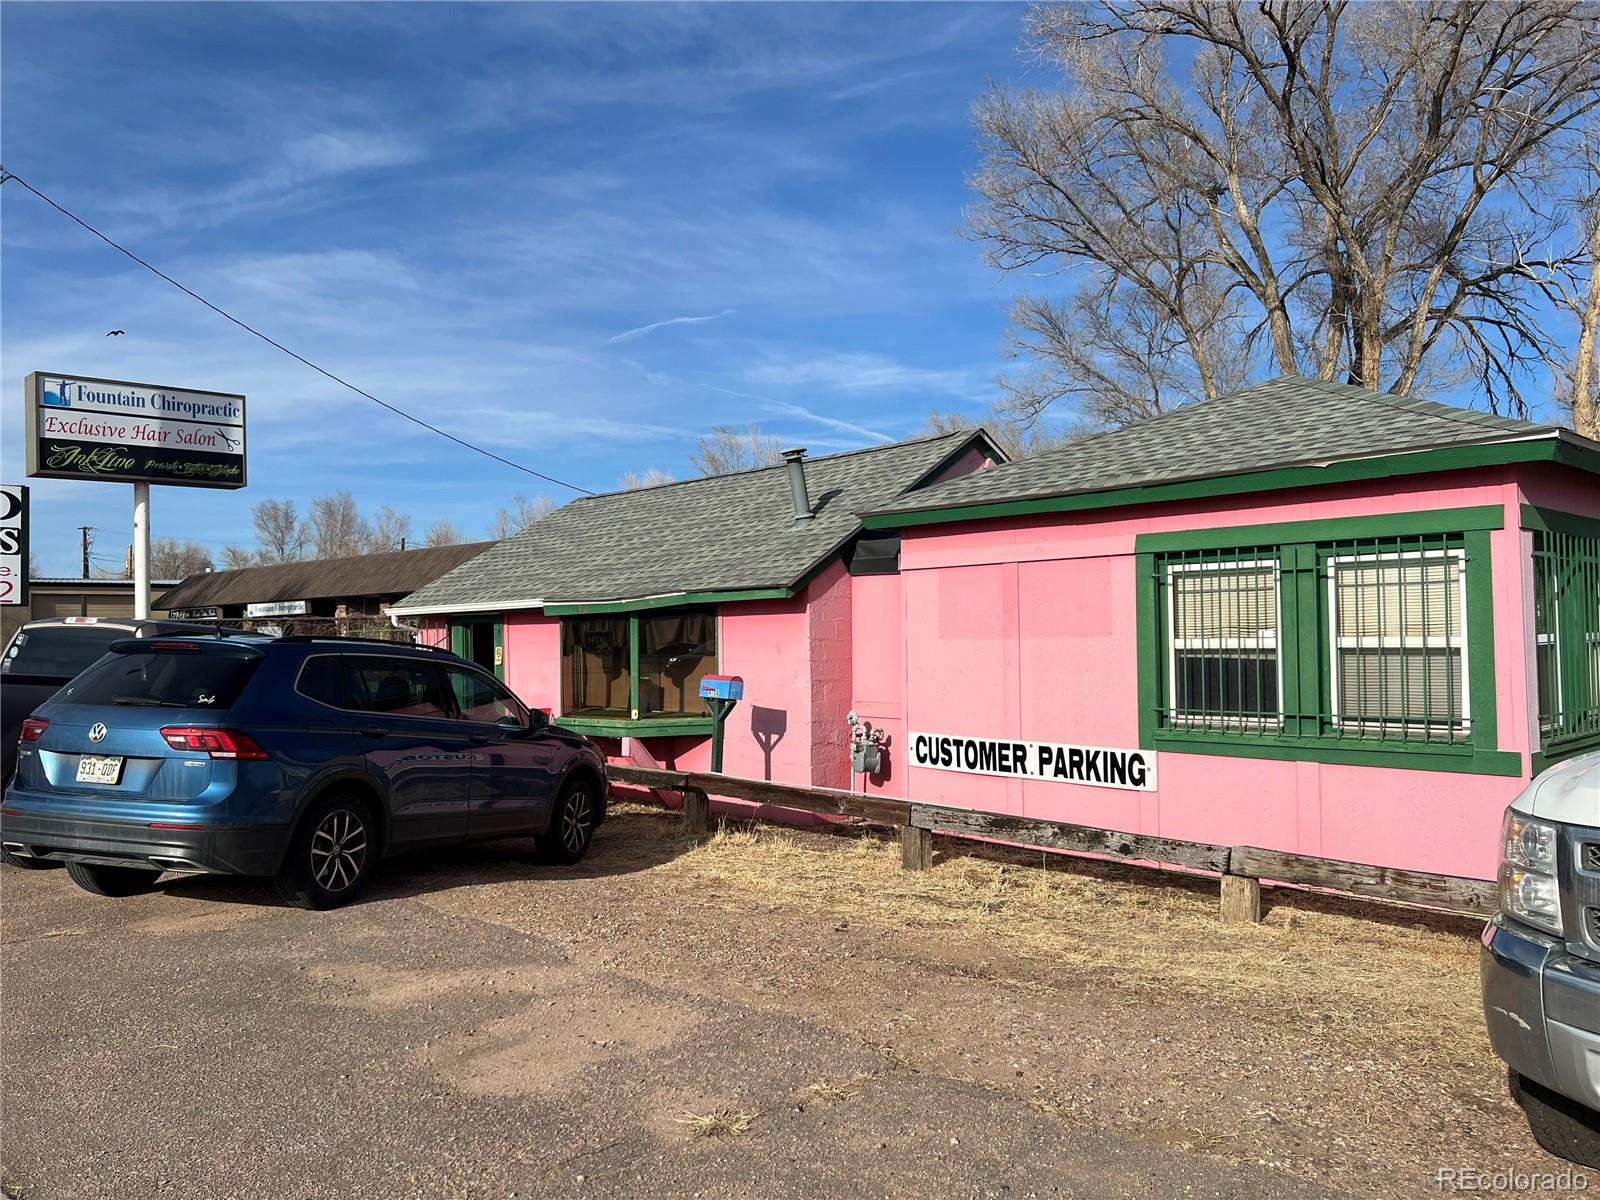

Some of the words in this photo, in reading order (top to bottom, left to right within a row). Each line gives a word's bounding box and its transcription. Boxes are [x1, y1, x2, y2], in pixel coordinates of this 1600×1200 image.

[77, 385, 146, 408] Fountain
[151, 393, 240, 419] Chiropractic
[45, 416, 125, 439] Exclusive
[130, 424, 171, 443] Hair
[176, 429, 216, 446] Salon
[915, 735, 1028, 775] CUSTOMER
[1038, 745, 1147, 787] PARKING
